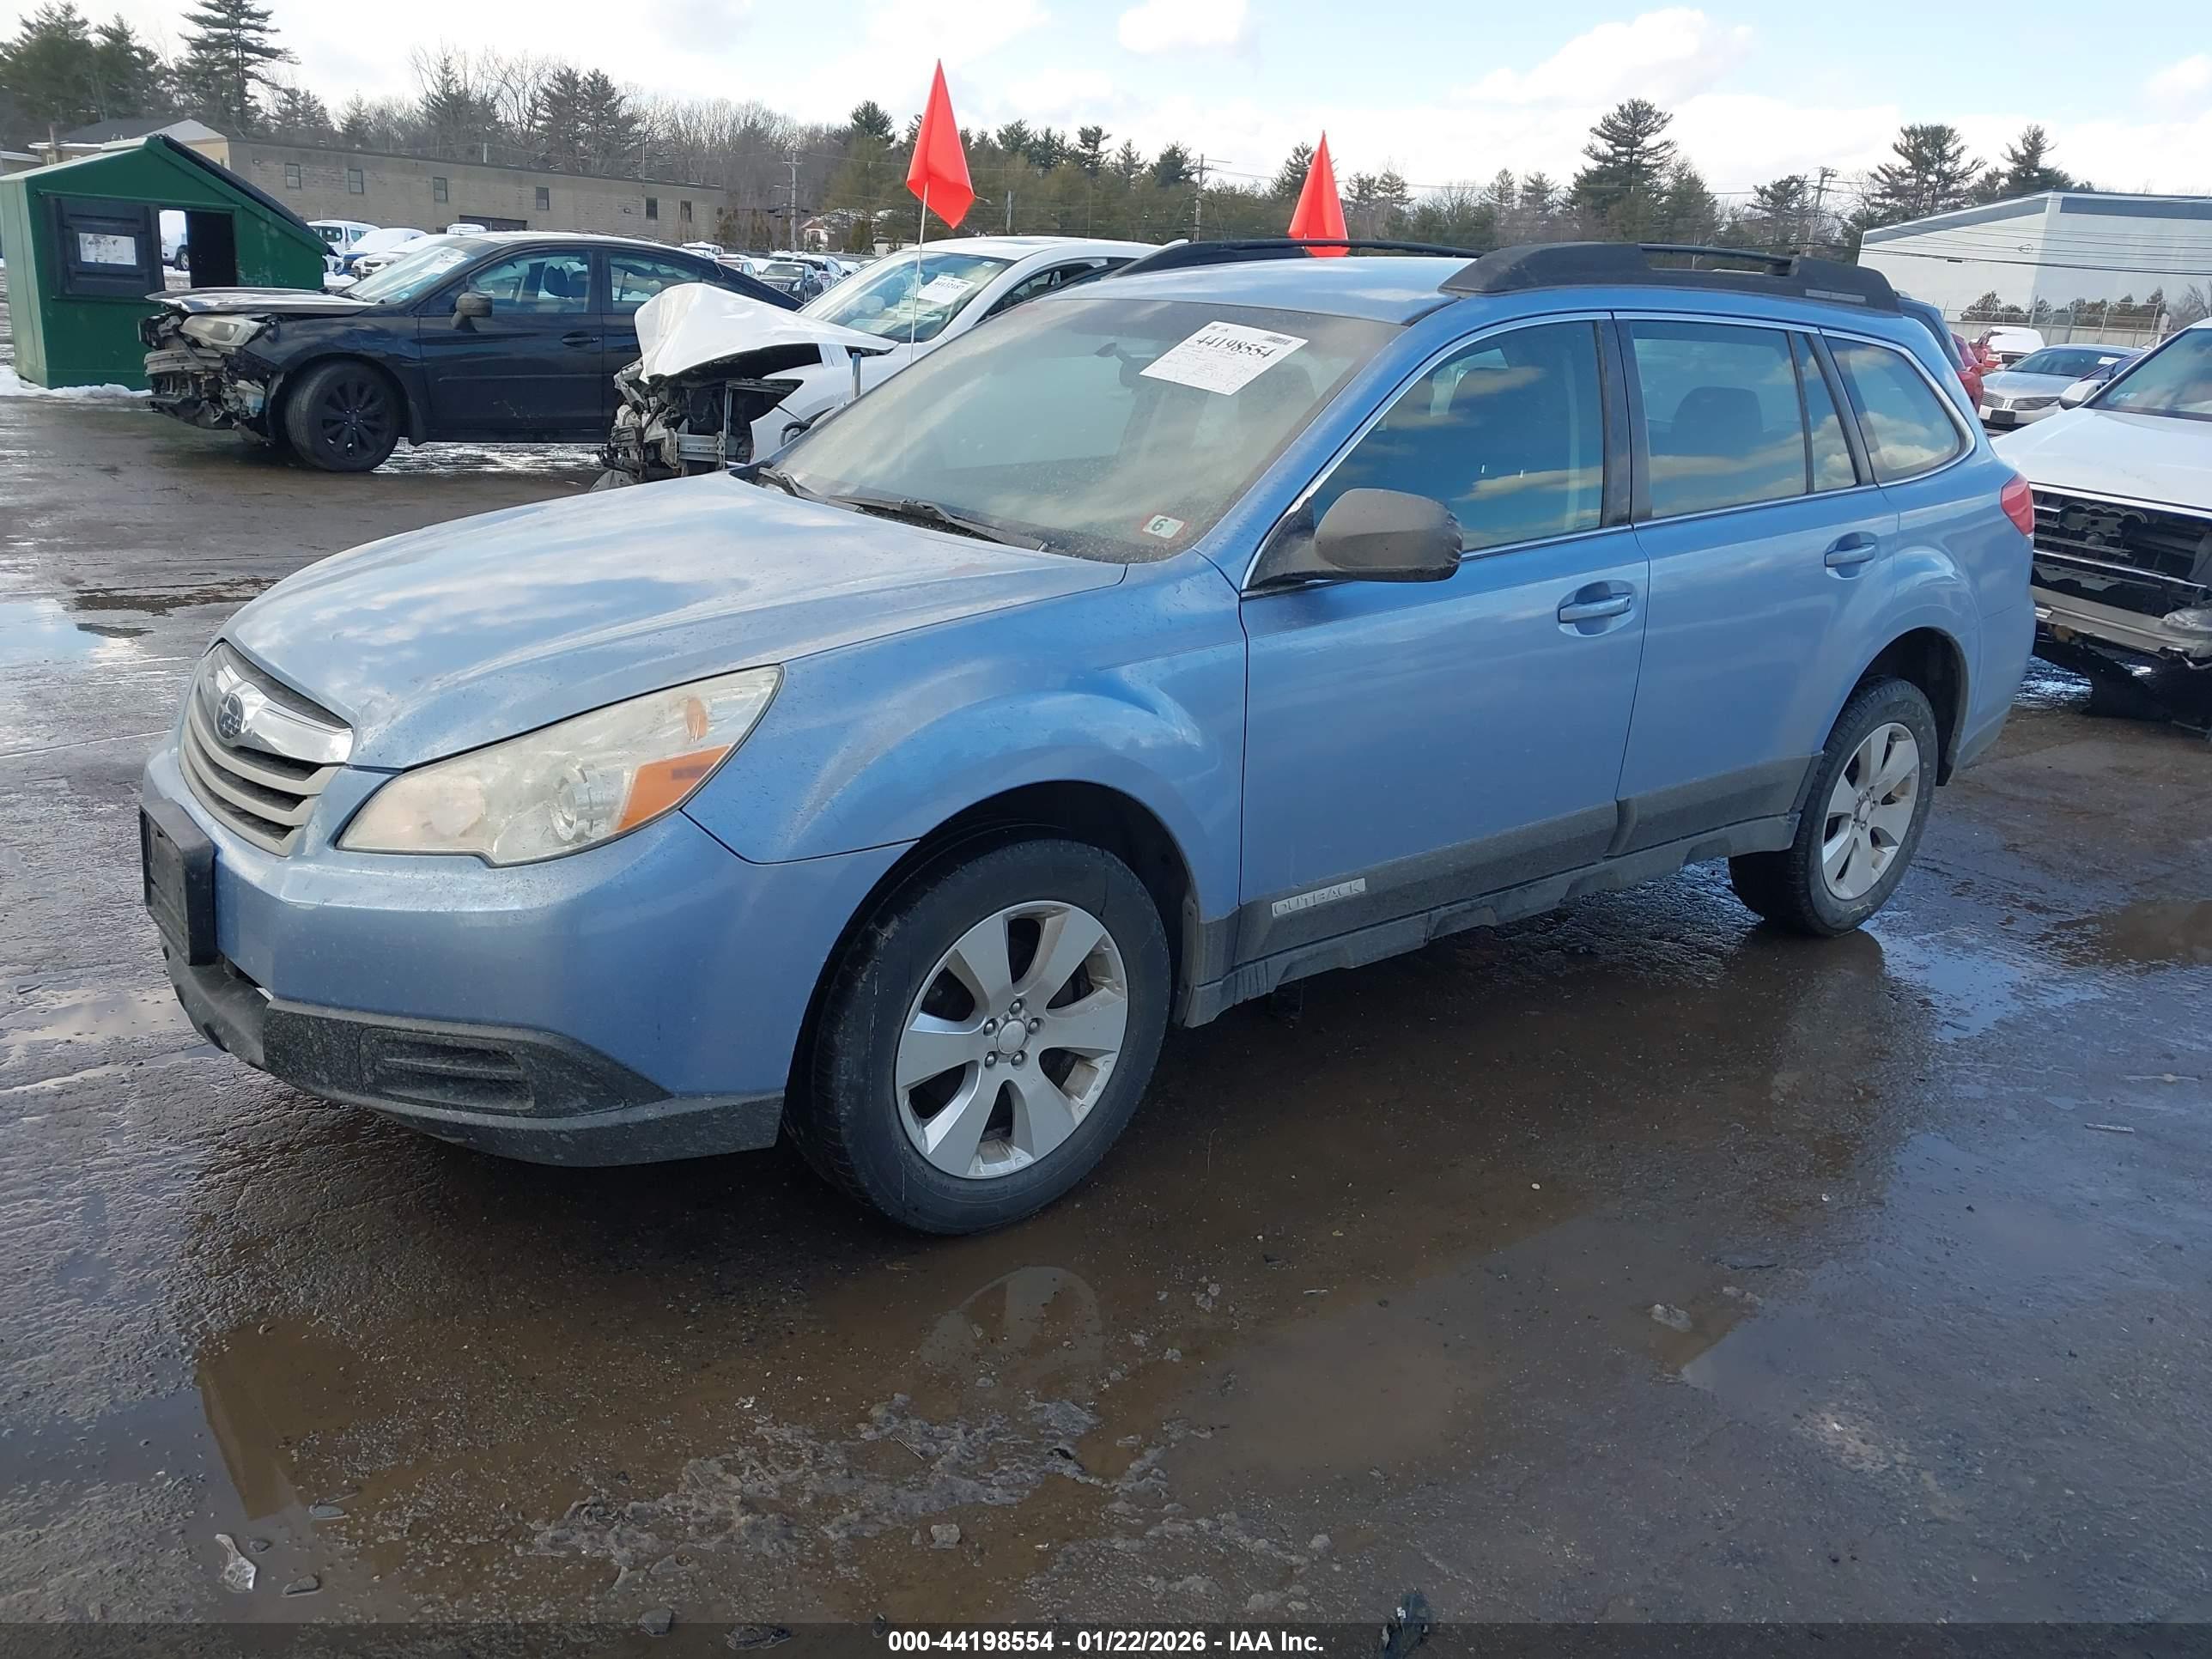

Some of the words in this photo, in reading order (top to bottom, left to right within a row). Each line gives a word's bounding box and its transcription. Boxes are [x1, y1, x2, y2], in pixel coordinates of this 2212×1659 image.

[1196, 335, 1277, 359] 44198554
[1152, 518, 1169, 532] 6
[1273, 879, 1363, 915] OUTBACK
